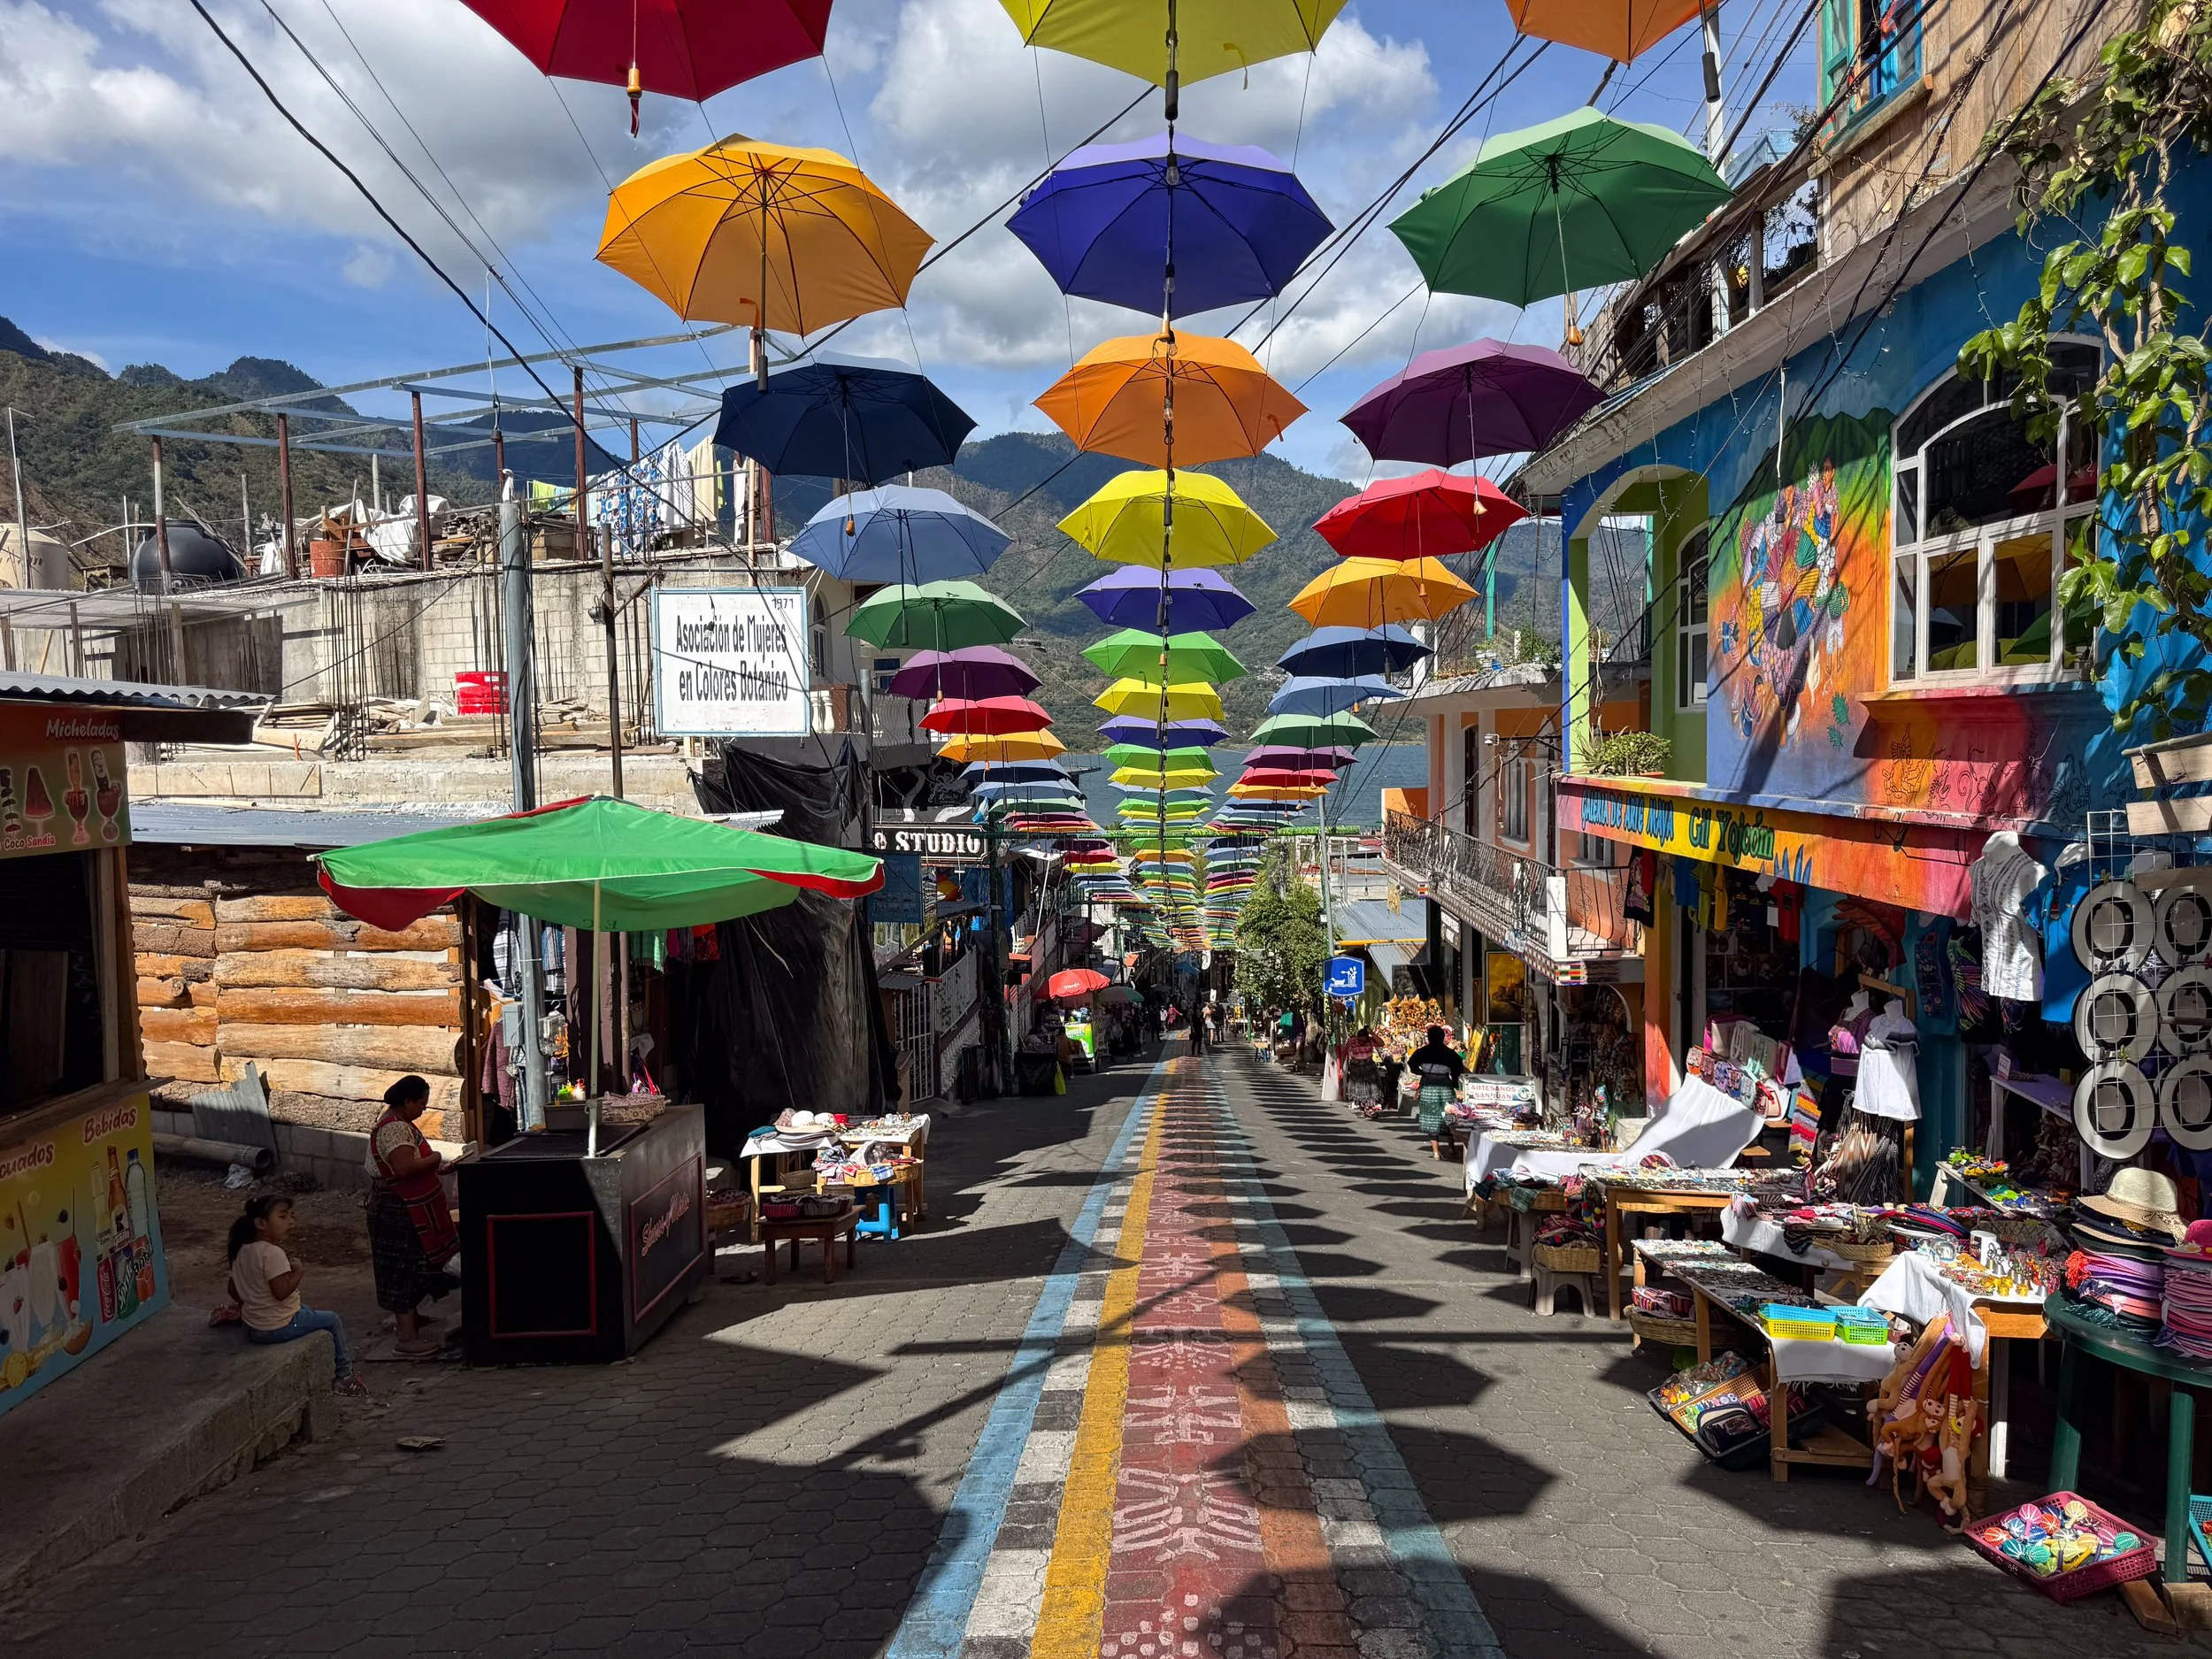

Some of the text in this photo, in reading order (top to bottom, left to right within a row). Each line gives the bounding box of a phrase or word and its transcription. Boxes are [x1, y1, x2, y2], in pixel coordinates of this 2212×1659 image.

[733, 615, 745, 653] de
[748, 615, 787, 664] Mujeres
[680, 660, 788, 702] en Colores Botanico
[46, 718, 120, 741] Micheladas
[1609, 792, 1623, 829] DE
[1624, 793, 1645, 834] ARTE
[1647, 797, 1674, 847] MAYA
[1688, 806, 1712, 849] Gil
[4, 838, 25, 849] Coco
[895, 831, 981, 854] STUDIO
[1471, 1084, 1517, 1093] ARTESANOS
[83, 1108, 137, 1144] Bebidas
